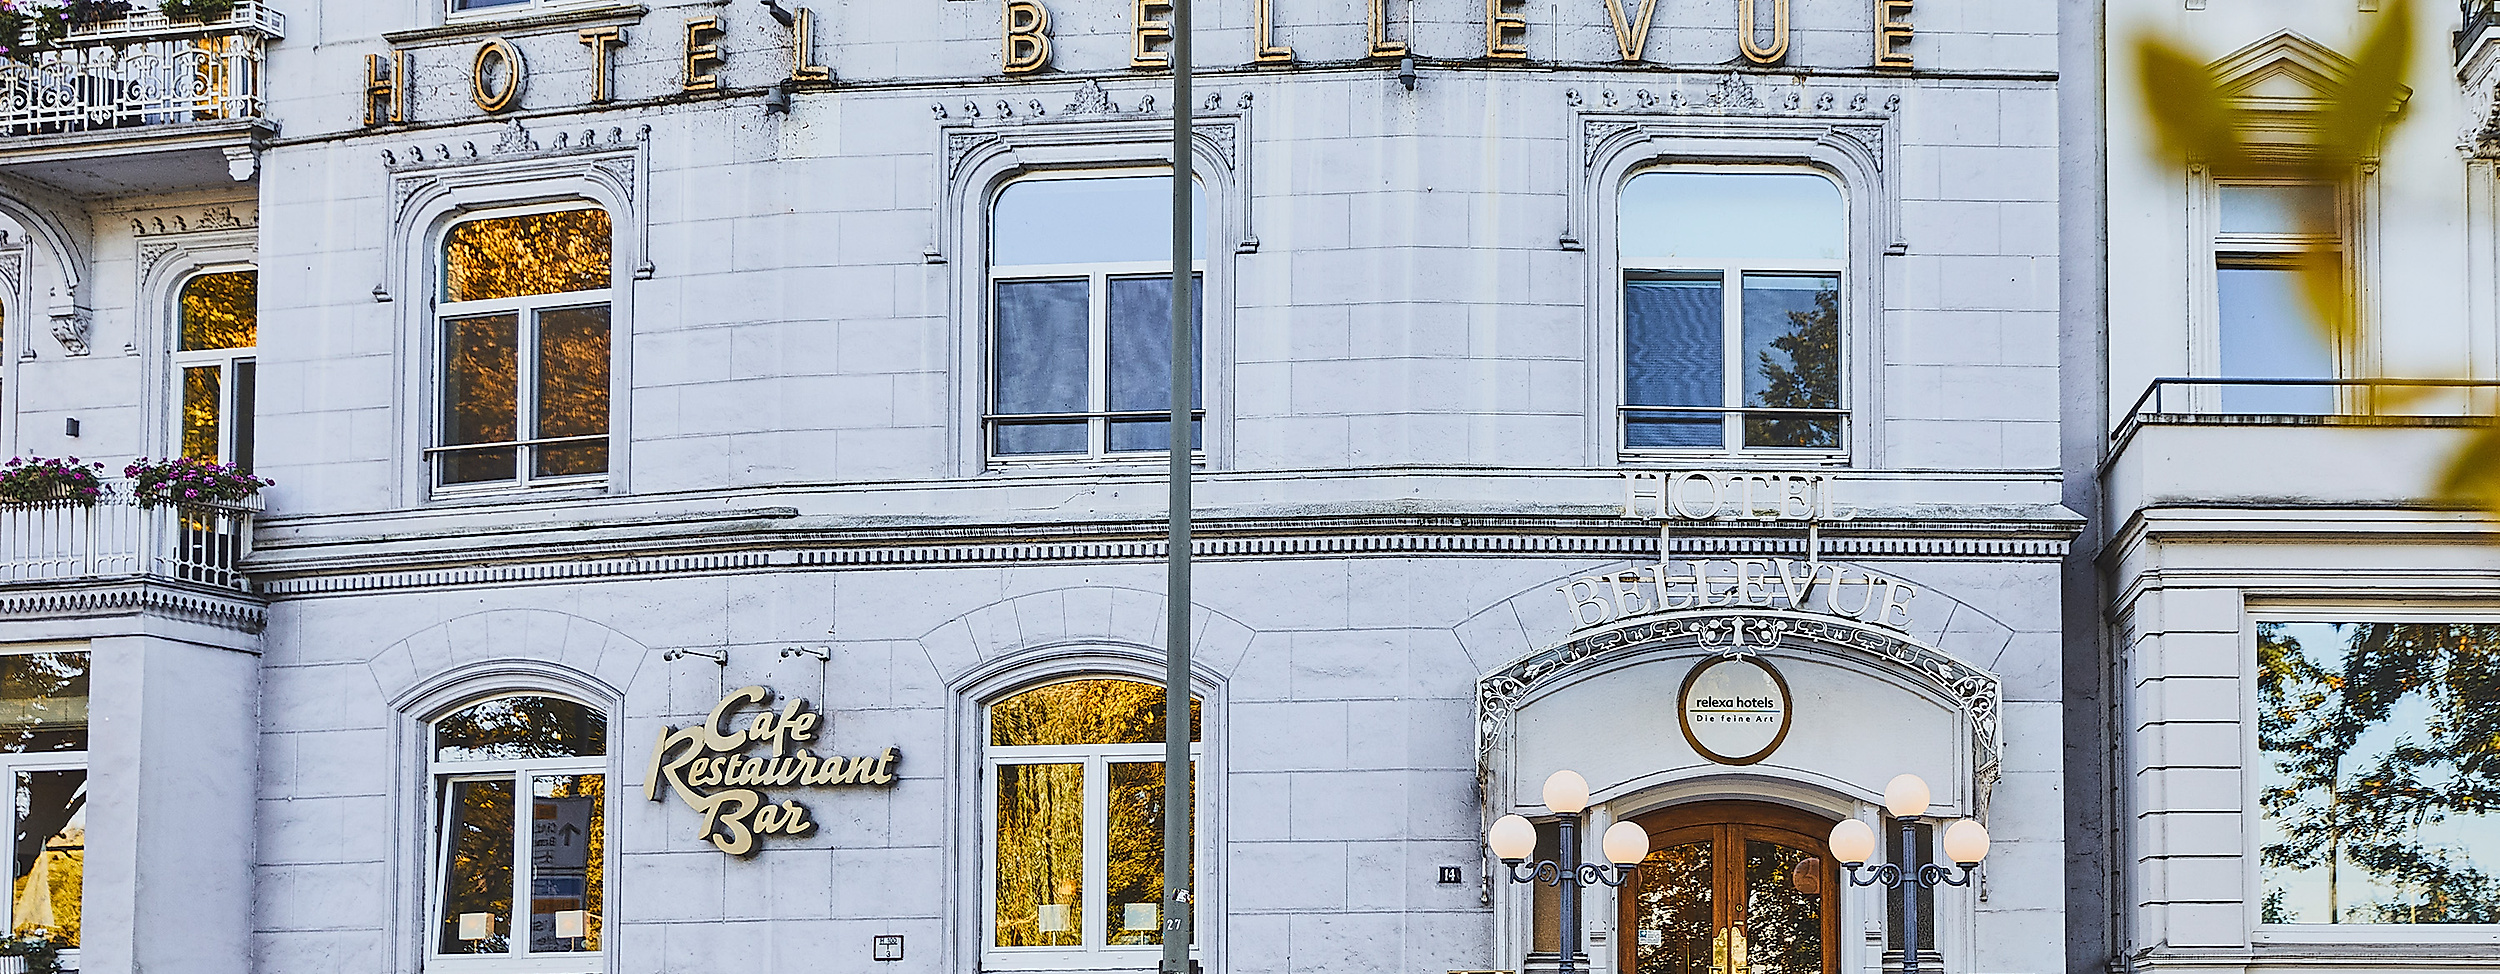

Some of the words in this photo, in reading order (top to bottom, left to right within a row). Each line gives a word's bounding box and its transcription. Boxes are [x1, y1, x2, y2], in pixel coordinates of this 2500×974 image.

[363, 7, 832, 126] HOTEL
[1002, 0, 1915, 75] BELLEVUE
[1619, 471, 1857, 521] HOTEL
[1556, 556, 1918, 636] BELLEVUE
[704, 685, 818, 758] Cafe
[1696, 695, 1733, 708] relexa
[1736, 695, 1774, 709] hotels
[1696, 714, 1715, 723] Die
[1721, 714, 1751, 723] feine
[1755, 714, 1774, 723] Art
[643, 725, 896, 814] Restaurant
[699, 788, 812, 855] Bar
[1444, 868, 1456, 882] 14
[1166, 918, 1182, 931] 27
[886, 950, 891, 958] 3
